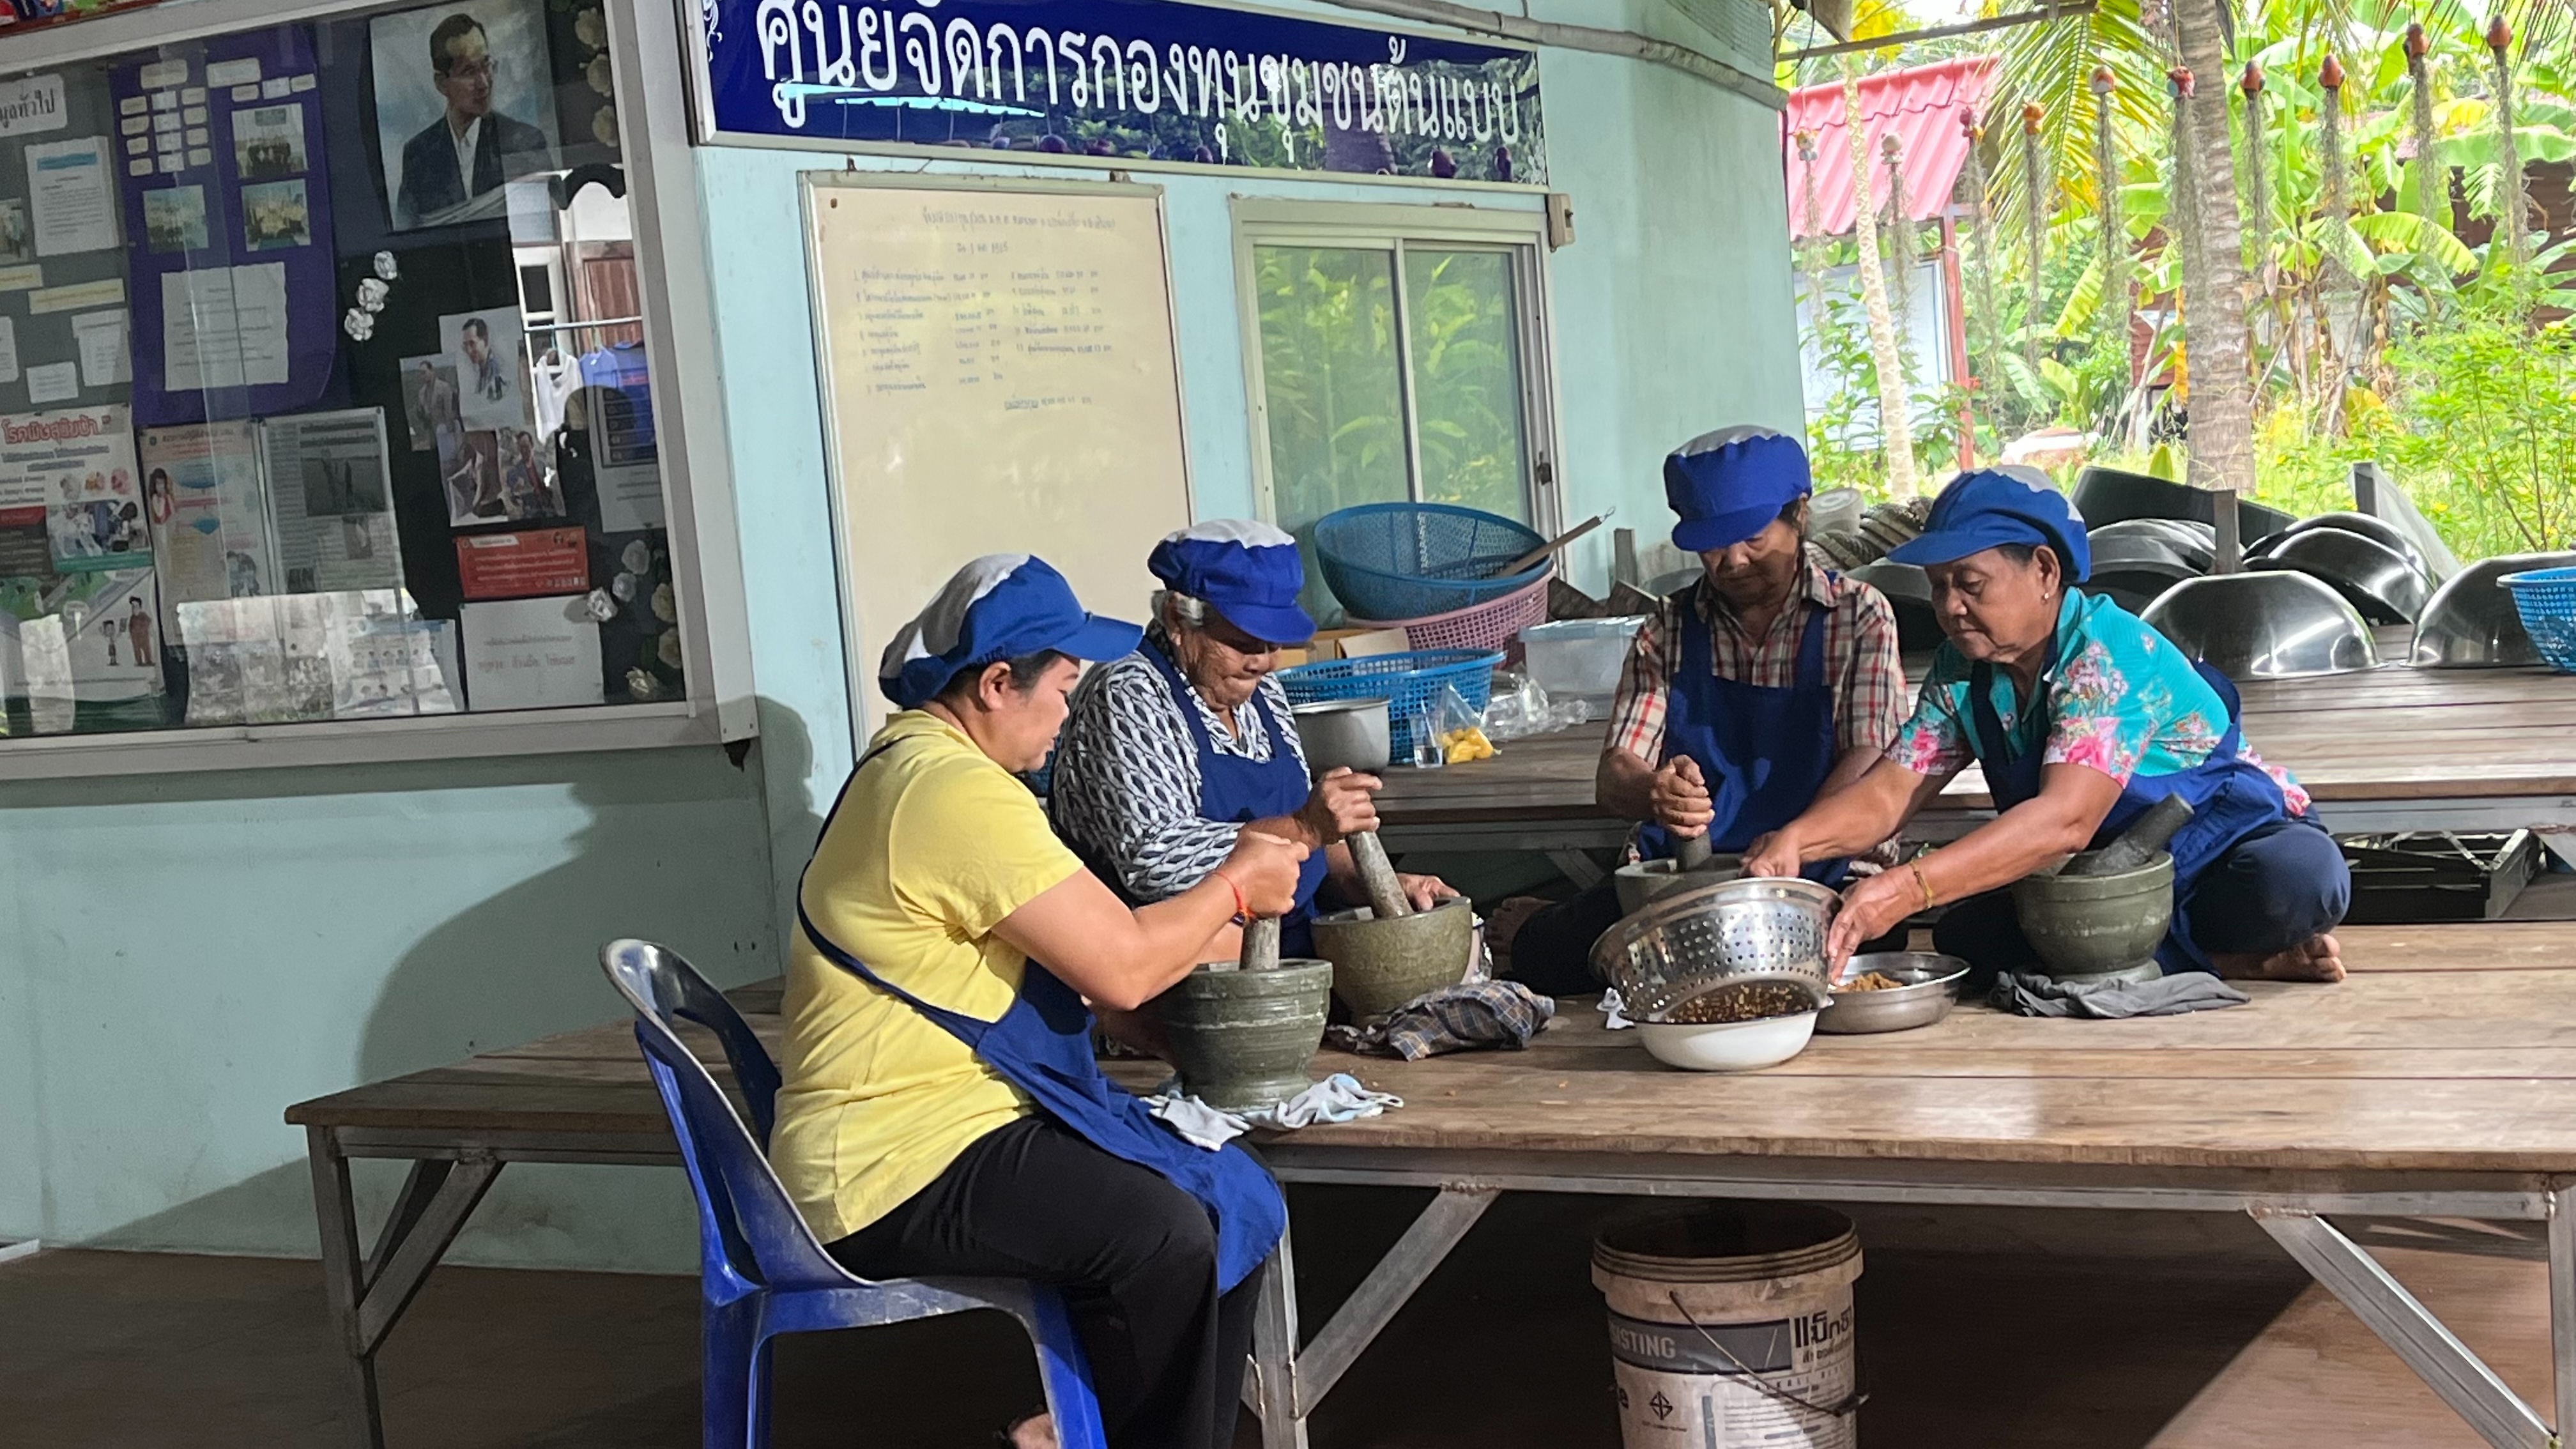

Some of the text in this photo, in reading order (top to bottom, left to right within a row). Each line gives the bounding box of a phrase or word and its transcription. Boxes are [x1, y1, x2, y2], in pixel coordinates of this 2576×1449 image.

[756, 0, 1520, 164] ศูนยจดการกองทุนชุมชนต้นแบบ
